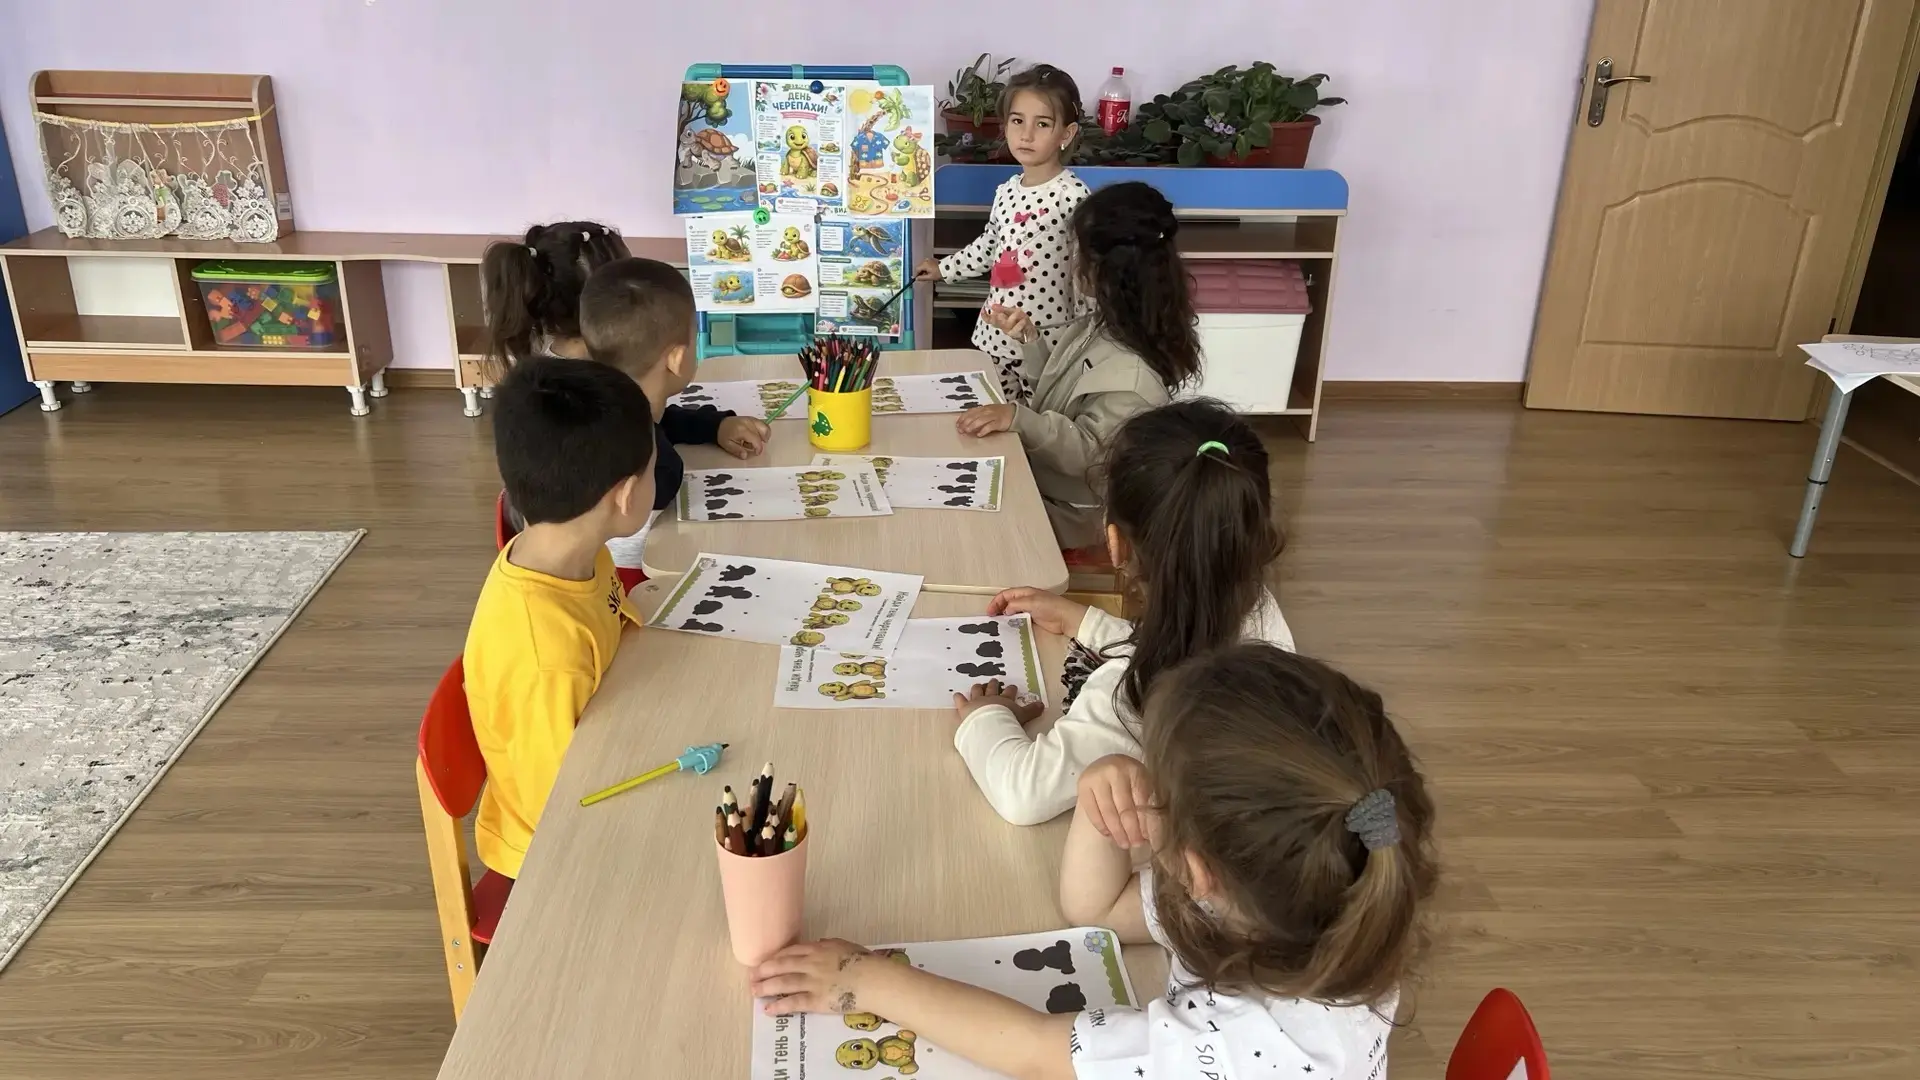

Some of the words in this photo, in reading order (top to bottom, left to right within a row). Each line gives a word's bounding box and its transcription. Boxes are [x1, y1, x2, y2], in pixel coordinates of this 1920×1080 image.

[787, 92, 812, 101] ДЕНЬ
[772, 101, 828, 114] ЧЕРЕПАХИ!
[892, 591, 910, 608] Найди
[886, 608, 898, 619] тень
[792, 659, 803, 672] тень
[786, 673, 802, 692] Найди
[774, 1035, 789, 1064] тень
